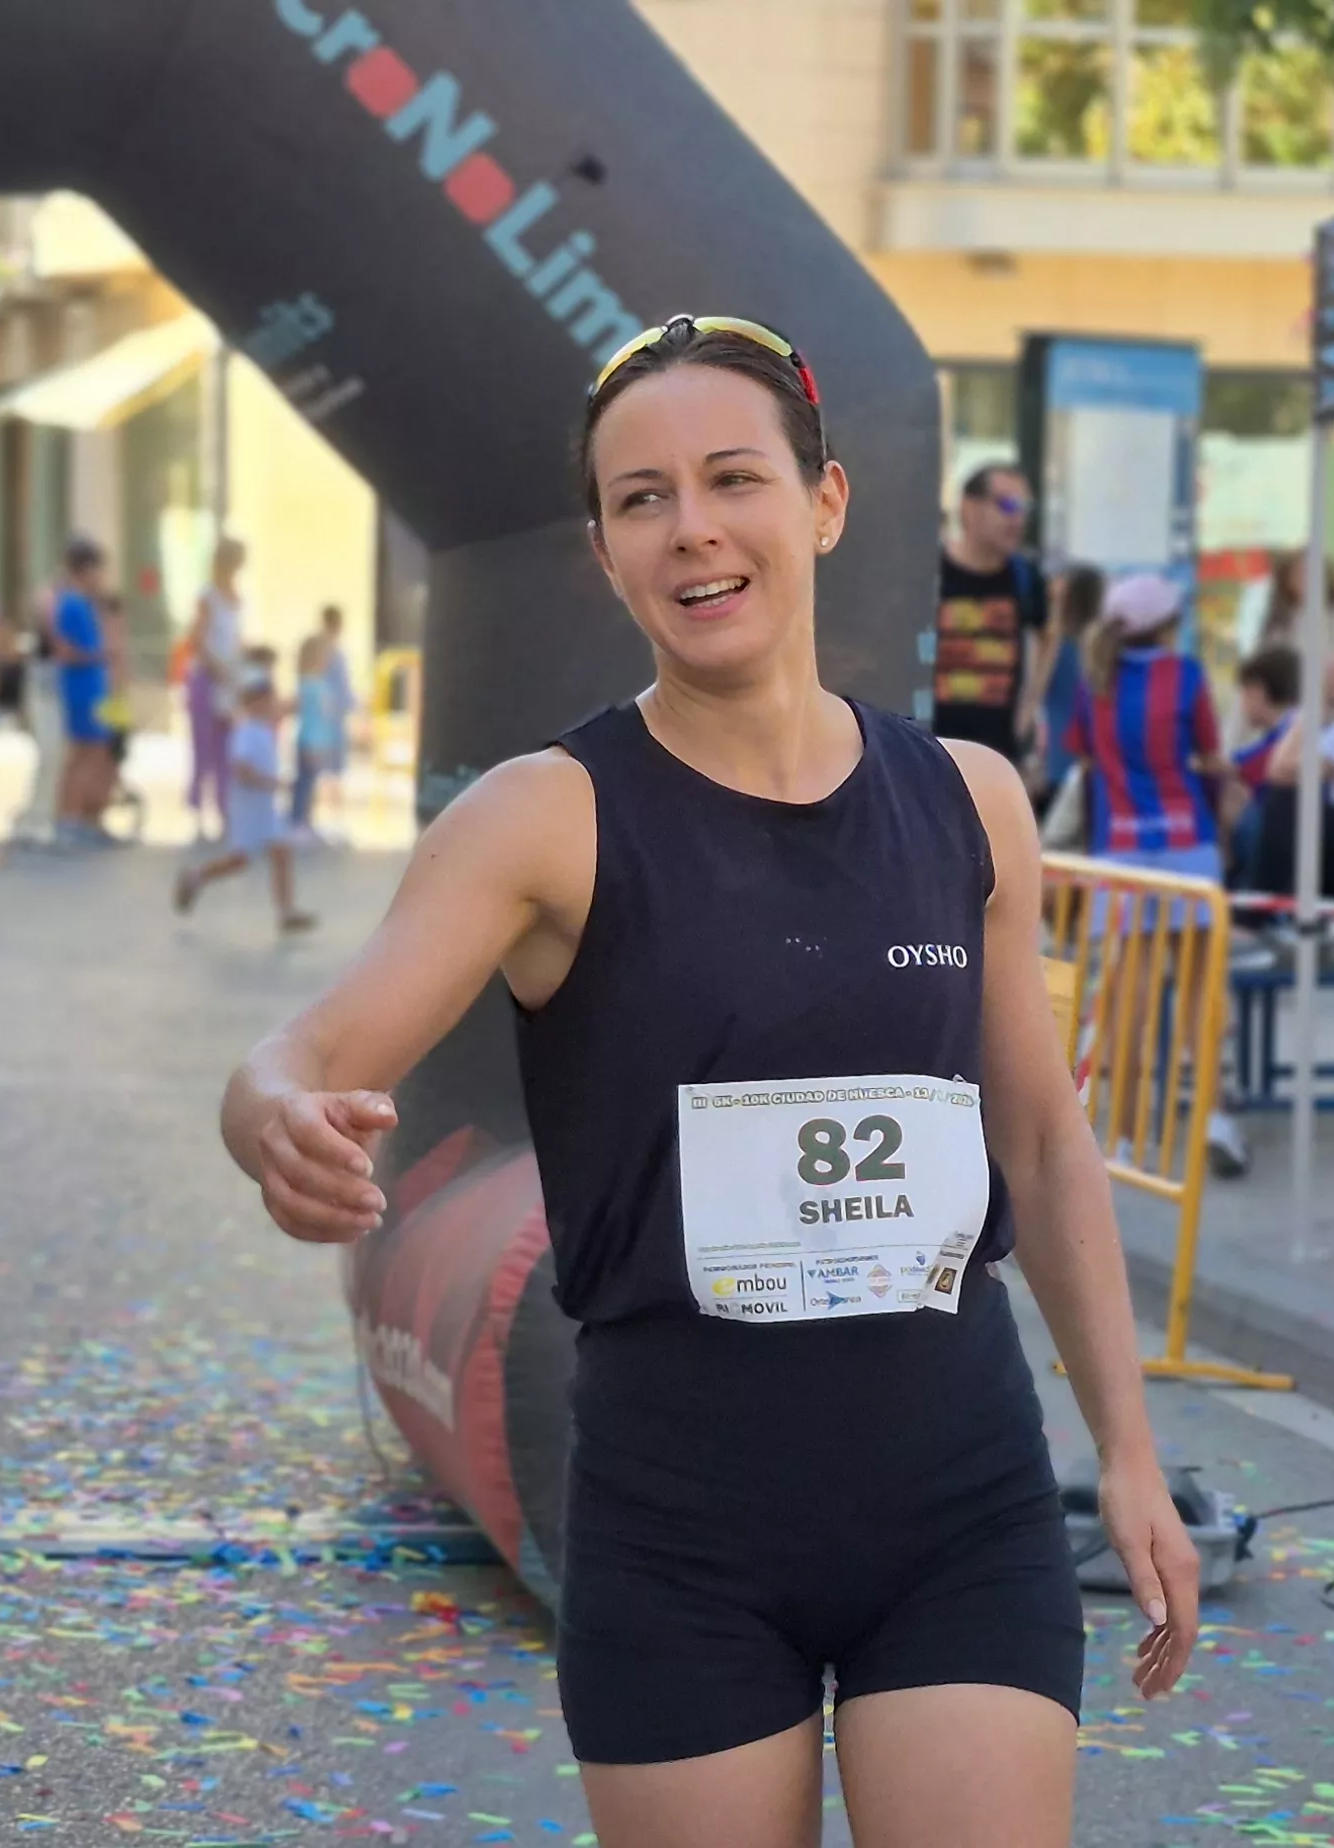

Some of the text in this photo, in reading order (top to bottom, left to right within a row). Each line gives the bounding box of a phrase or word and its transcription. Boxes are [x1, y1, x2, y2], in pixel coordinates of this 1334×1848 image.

[887, 943, 968, 969] OYSHO
[742, 1092, 770, 1107] 10K
[771, 1091, 825, 1105] CIUDAD
[826, 1089, 846, 1102] DE
[848, 1087, 905, 1101] HUESCA
[797, 1114, 906, 1186] 82
[799, 1194, 915, 1225] SHEILA
[818, 1266, 859, 1279] AMBAR
